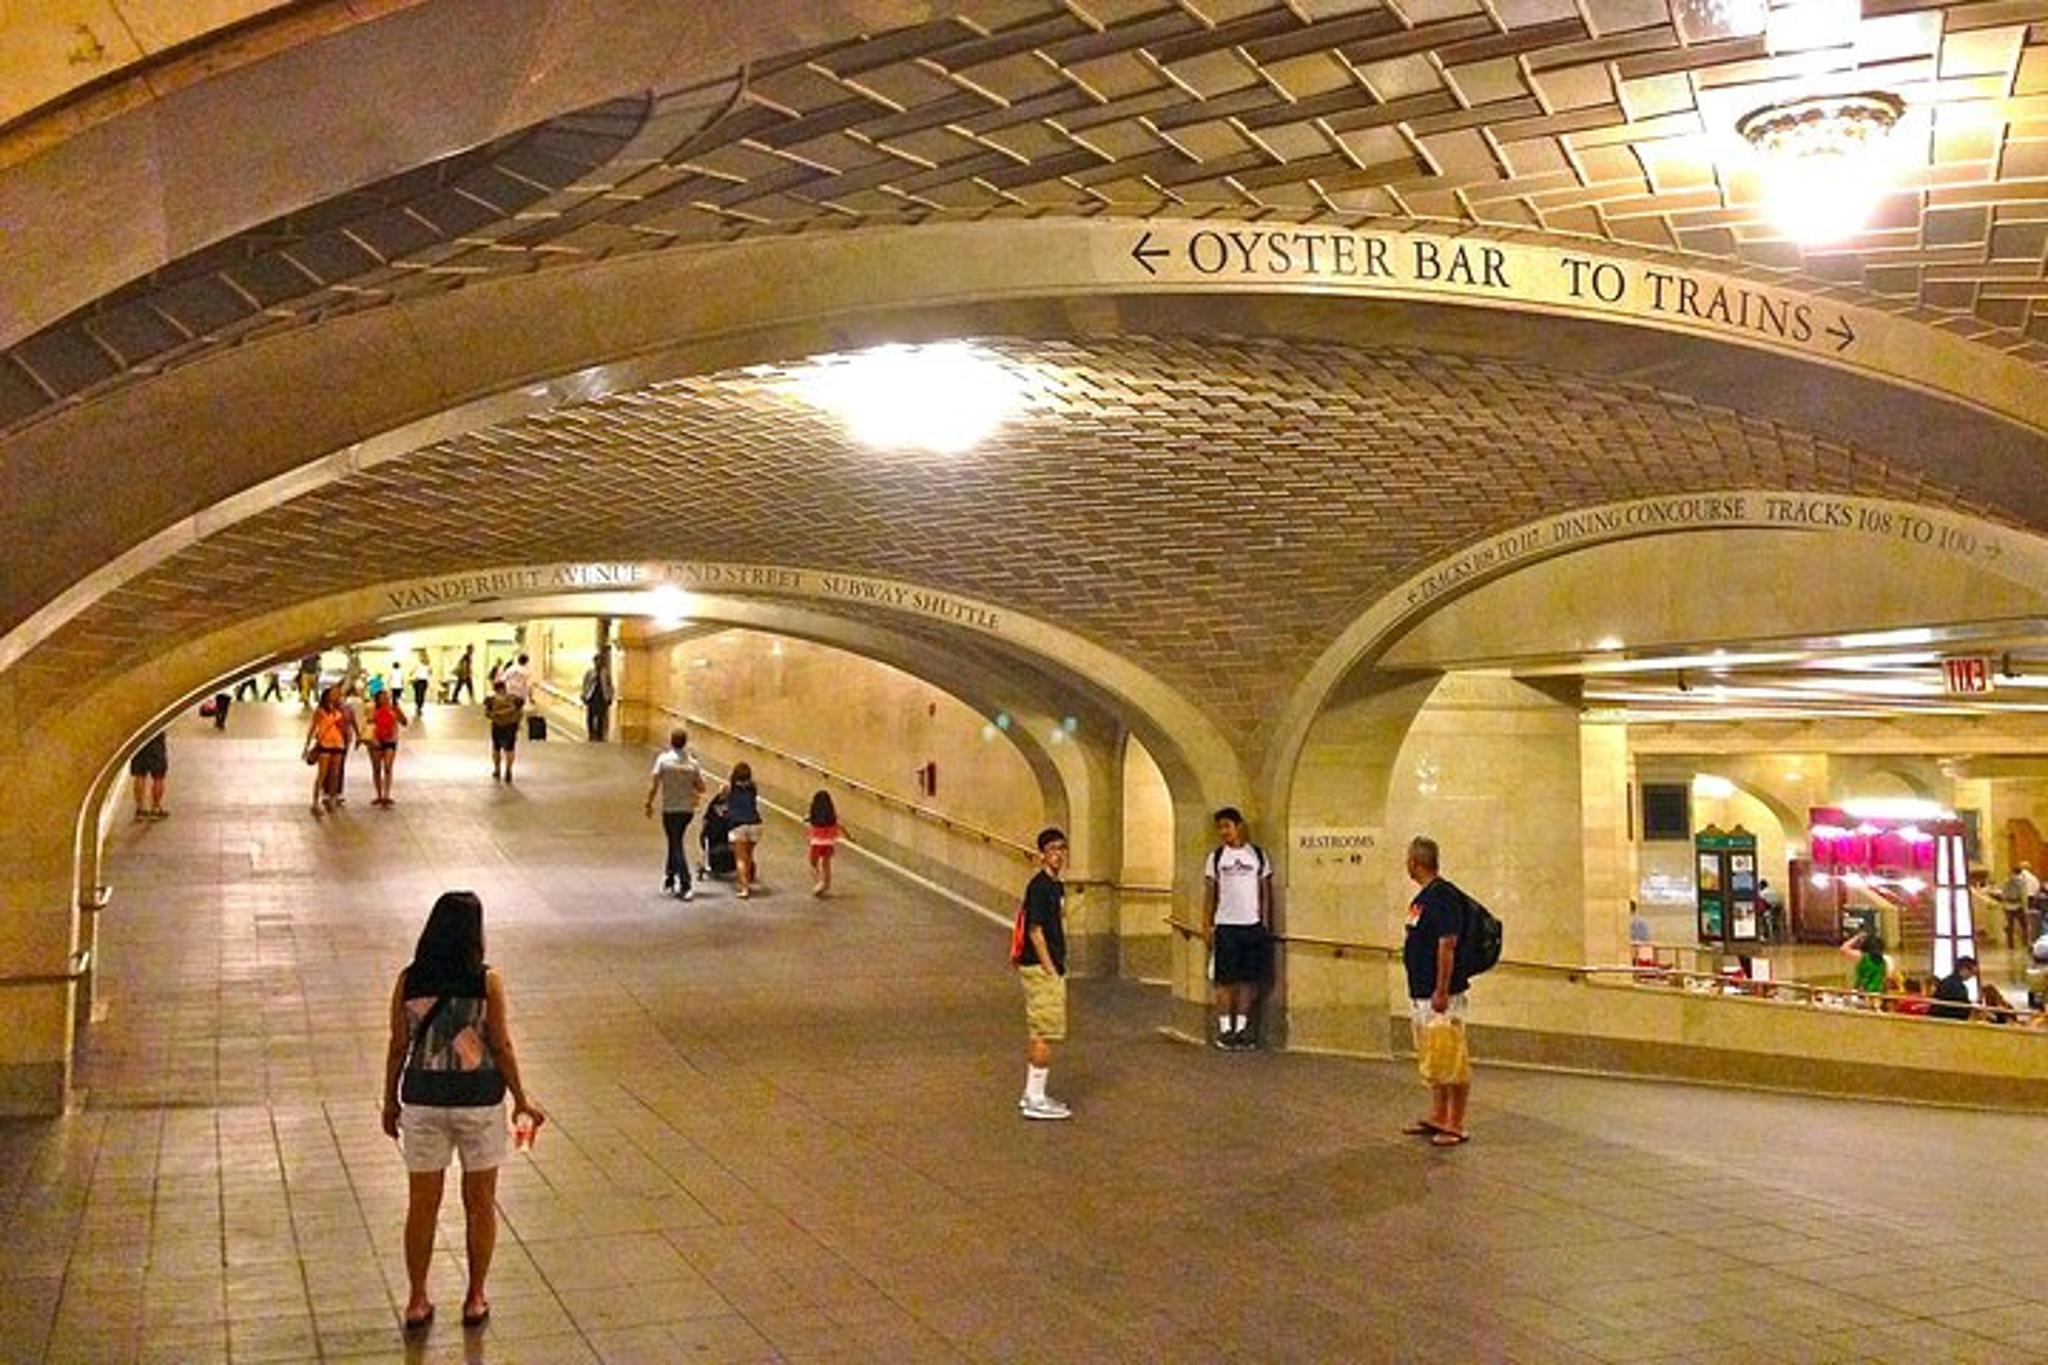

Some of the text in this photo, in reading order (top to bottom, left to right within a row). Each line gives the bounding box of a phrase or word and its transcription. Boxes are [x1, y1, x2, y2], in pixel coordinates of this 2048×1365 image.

[1187, 229, 1813, 343] OYSTER BAR TO TRAINS
[1551, 510, 1622, 543] DINING
[1625, 497, 1746, 525] CONCOURSE
[1764, 499, 1853, 527] TRACKS
[1857, 507, 1893, 535] 108
[1900, 514, 1934, 544] TO
[388, 570, 543, 610] VANDERBILT
[550, 564, 644, 585] AVENUE
[724, 566, 801, 588] STREET
[821, 575, 908, 606] SUBWAY
[911, 592, 1001, 631] SHUTTLE
[1299, 834, 1376, 849] RESTROOMS
